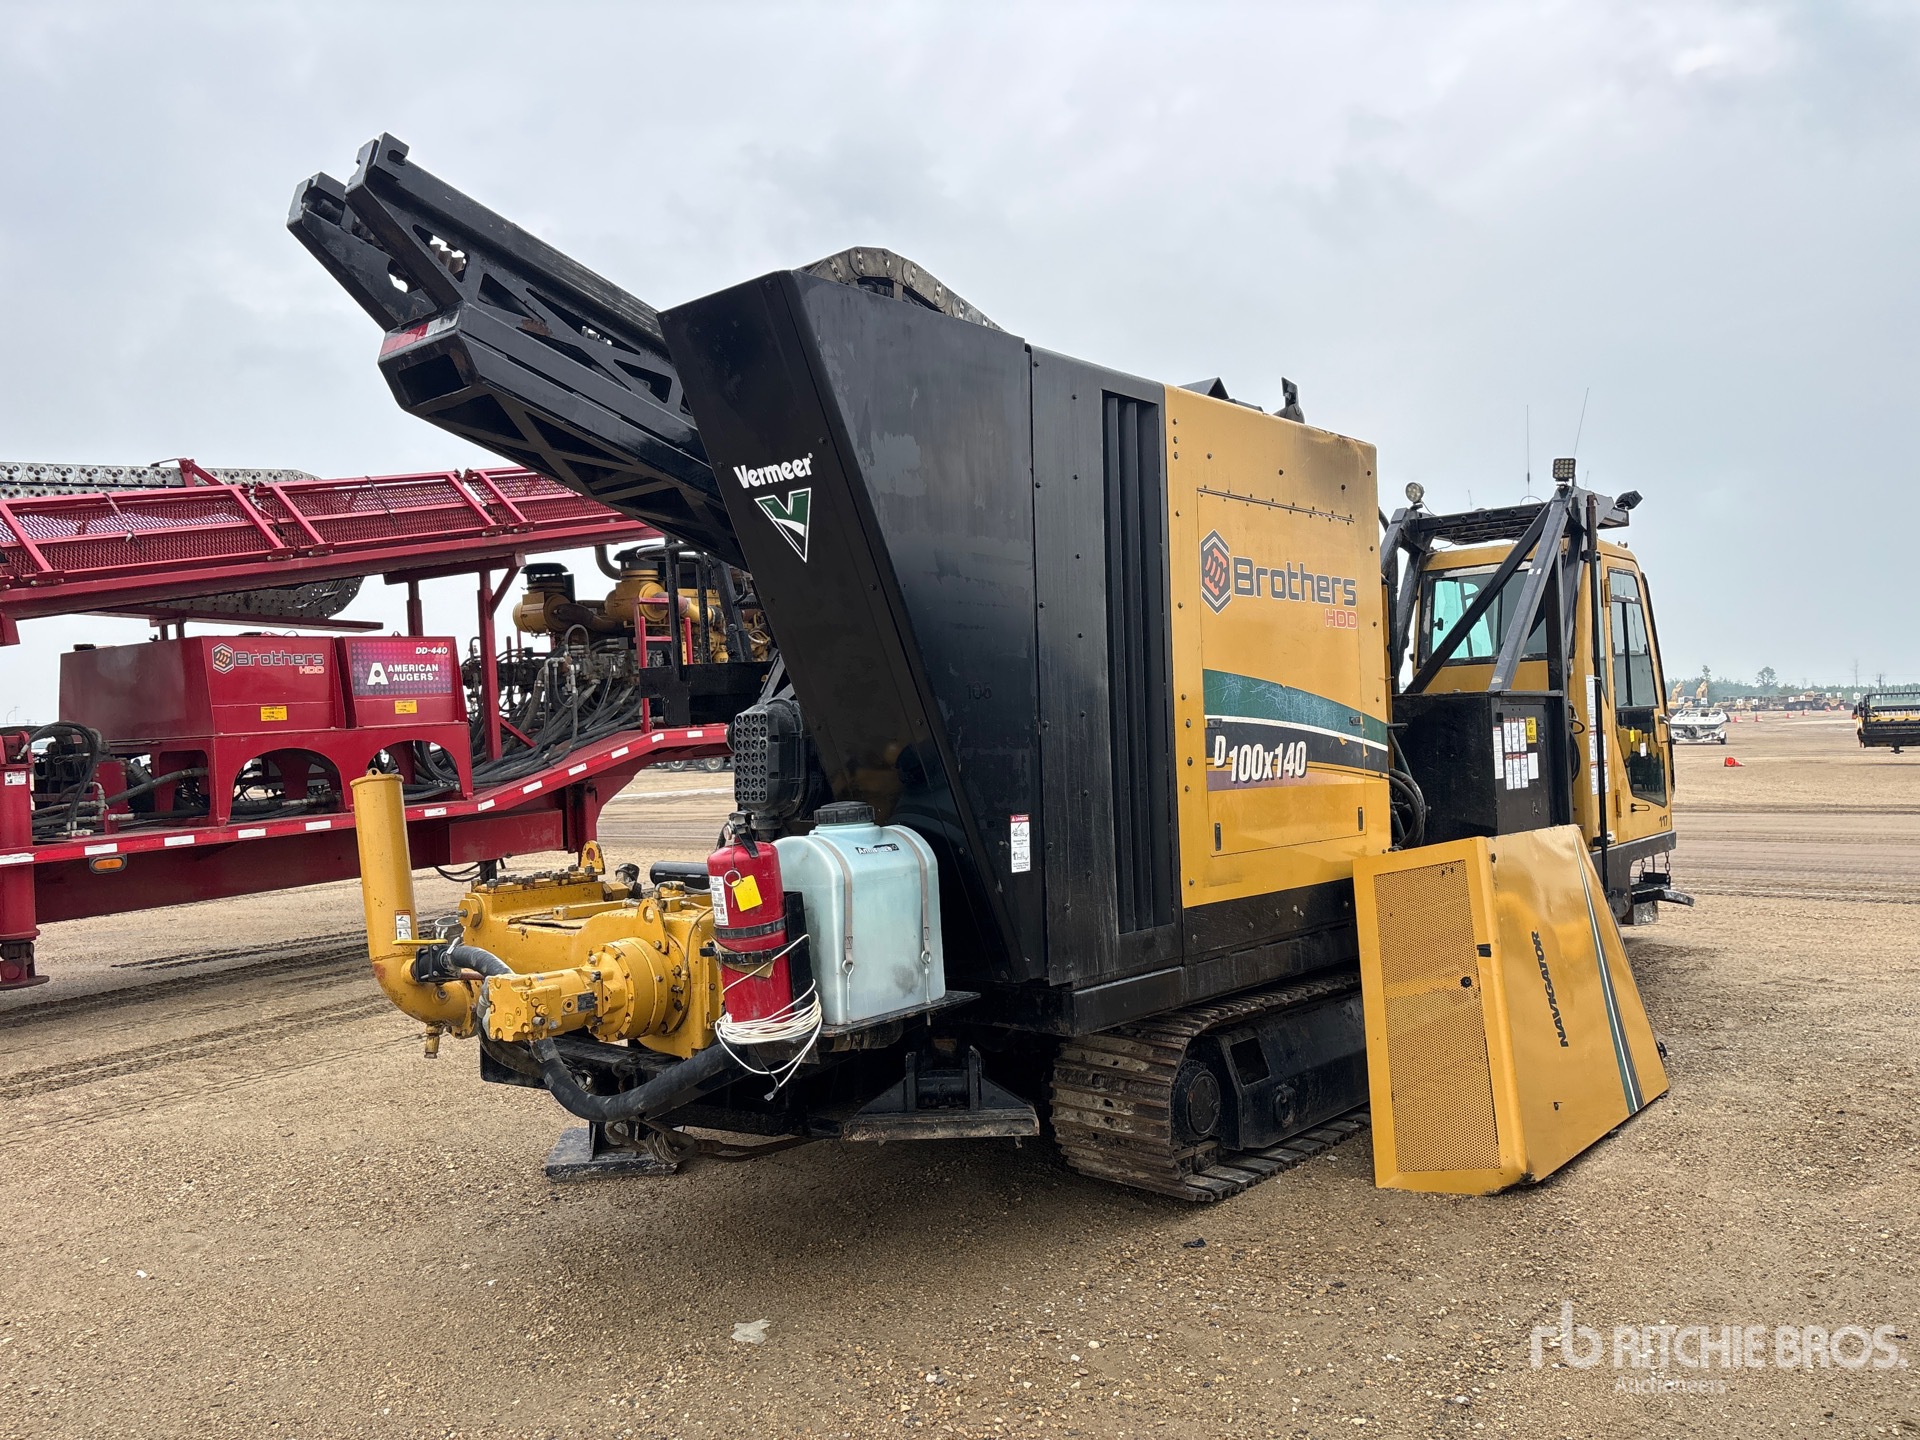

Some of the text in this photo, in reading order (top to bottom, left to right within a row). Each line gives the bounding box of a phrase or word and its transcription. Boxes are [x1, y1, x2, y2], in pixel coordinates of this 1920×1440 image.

[733, 457, 812, 489] Vermeer
[1233, 556, 1358, 607] Brothers
[1325, 608, 1358, 629] HDD
[234, 650, 324, 666] Brothers
[415, 646, 448, 655] DD-440
[298, 665, 325, 675] HDD
[387, 664, 439, 673] AMERICAN
[392, 673, 434, 681] AUGERS
[1214, 735, 1308, 783] D 100x140
[1531, 931, 1569, 1048] NAVIGATOR
